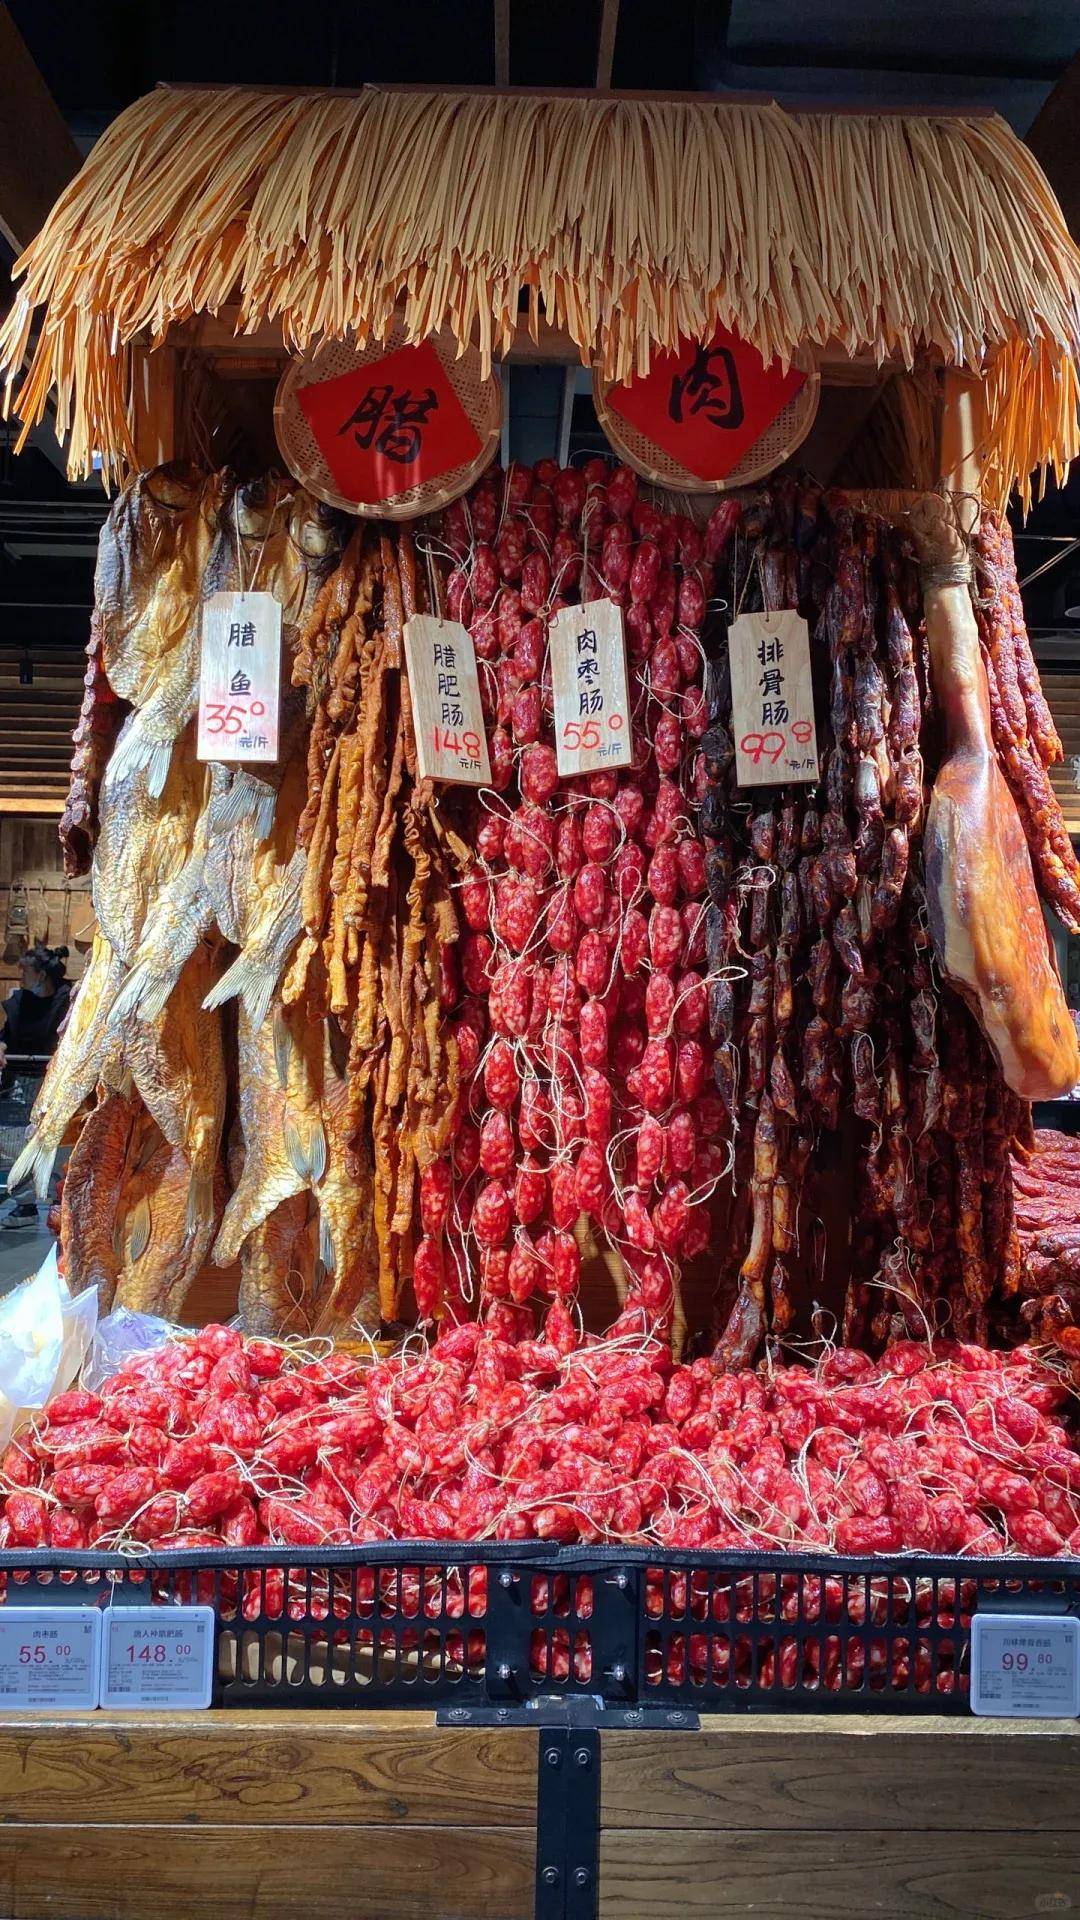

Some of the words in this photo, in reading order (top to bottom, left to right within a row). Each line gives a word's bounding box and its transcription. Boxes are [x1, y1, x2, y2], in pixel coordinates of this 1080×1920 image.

[338, 385, 439, 463] 腊
[668, 345, 744, 429] 肉
[228, 622, 256, 696] 腊鱼
[434, 643, 463, 727] 腊肥肠
[577, 629, 603, 716] 肉枣肠
[757, 637, 788, 726] 排骨肠
[239, 736, 268, 749] 元/斤
[433, 726, 480, 759] 148
[458, 758, 482, 770] 元/斤
[597, 743, 623, 756] 元/斤
[789, 759, 815, 769] 元/斤
